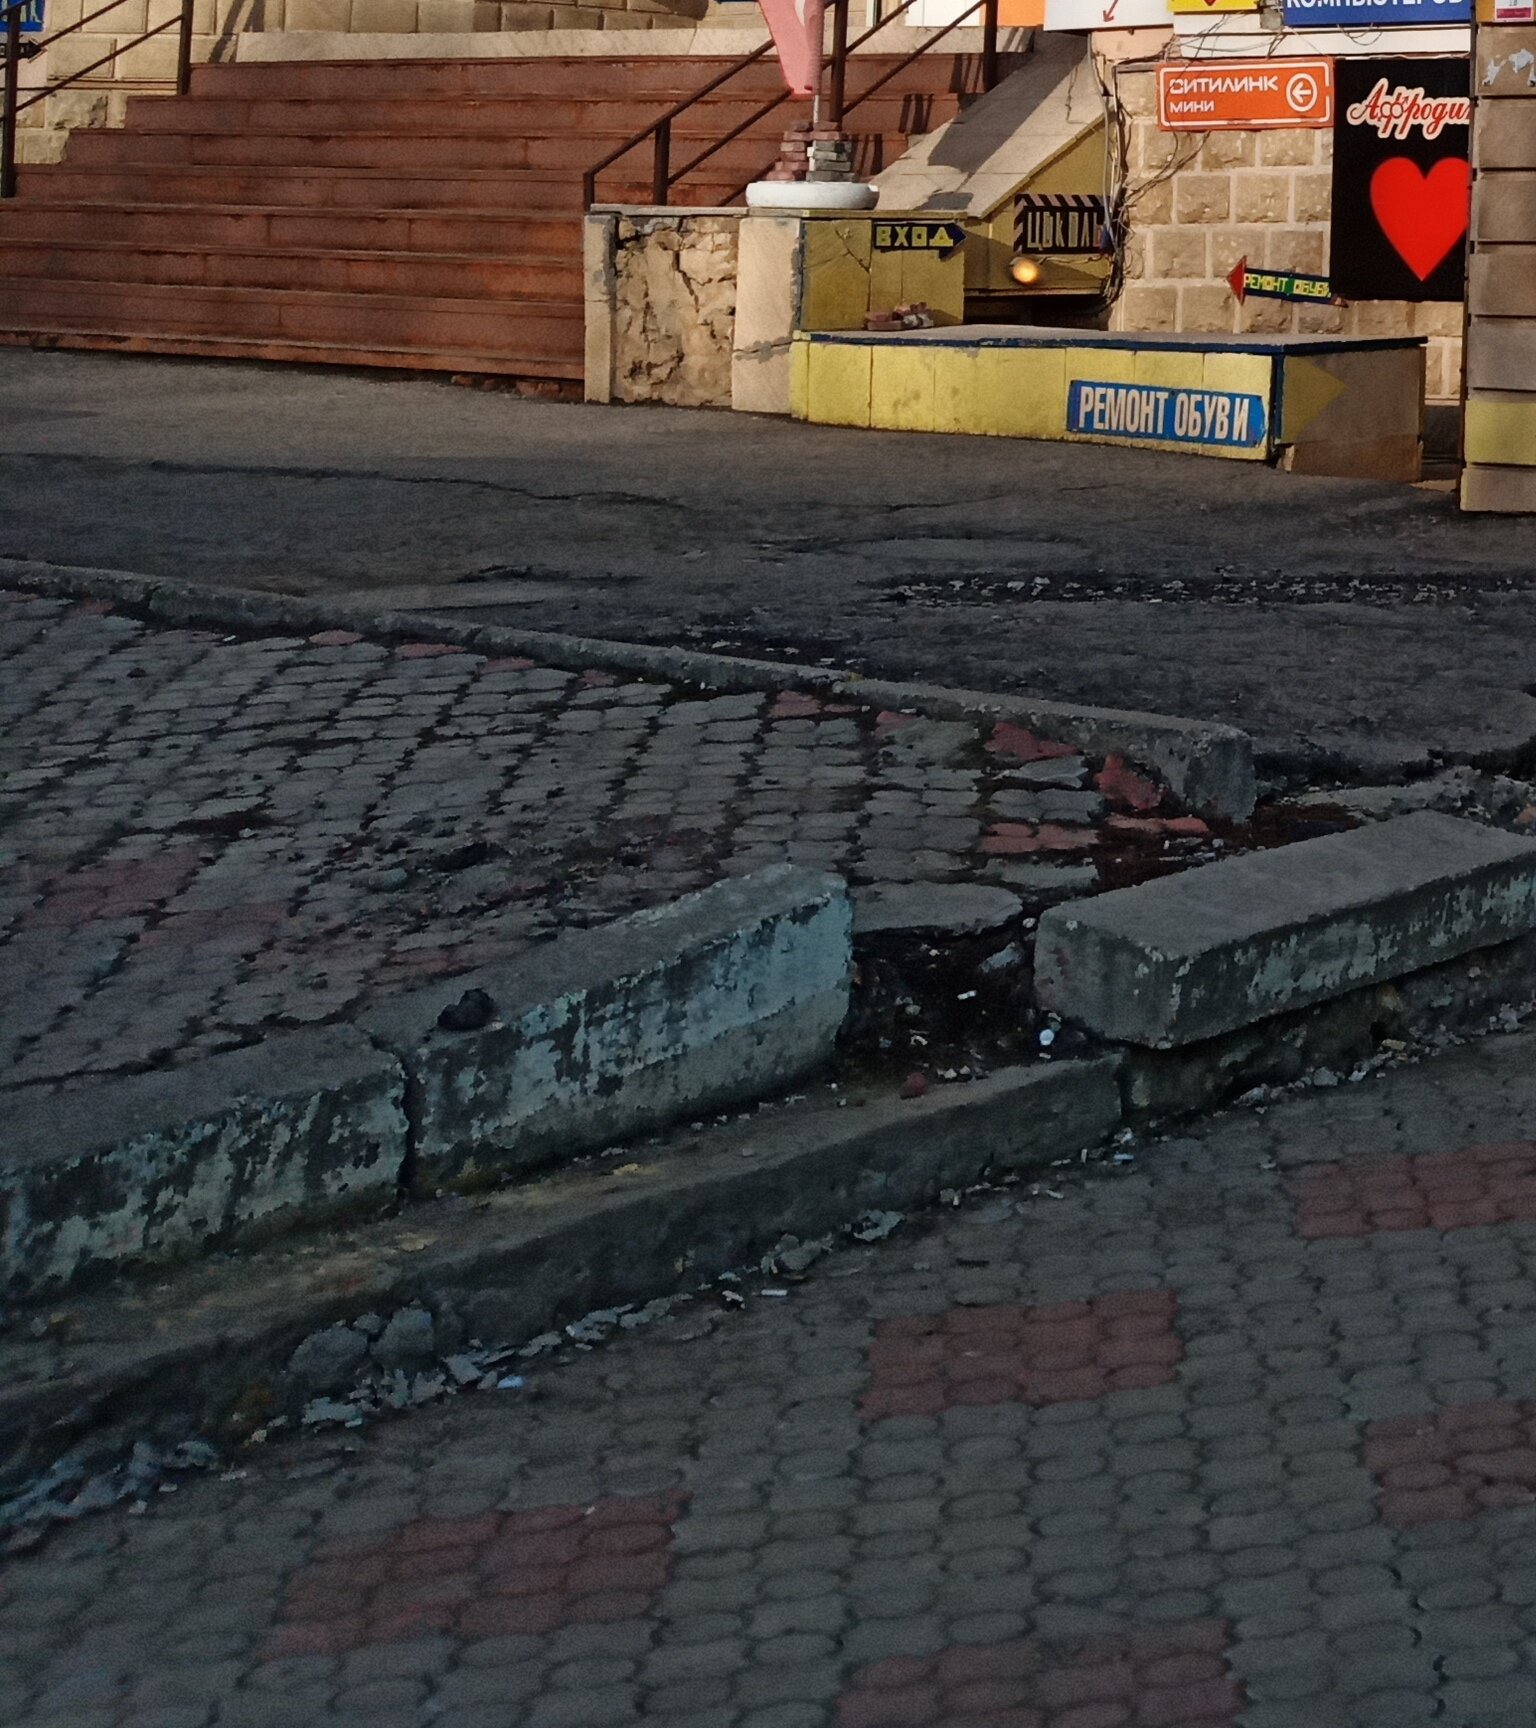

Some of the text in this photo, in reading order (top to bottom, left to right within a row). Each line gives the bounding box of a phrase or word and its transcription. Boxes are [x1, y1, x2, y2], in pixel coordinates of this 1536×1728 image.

[1169, 100, 1216, 114] МИНИ
[1349, 81, 1469, 136] Афроди
[874, 223, 955, 249] ВХОД
[1078, 385, 1249, 442] РЕМОНТ ОБУВИ
